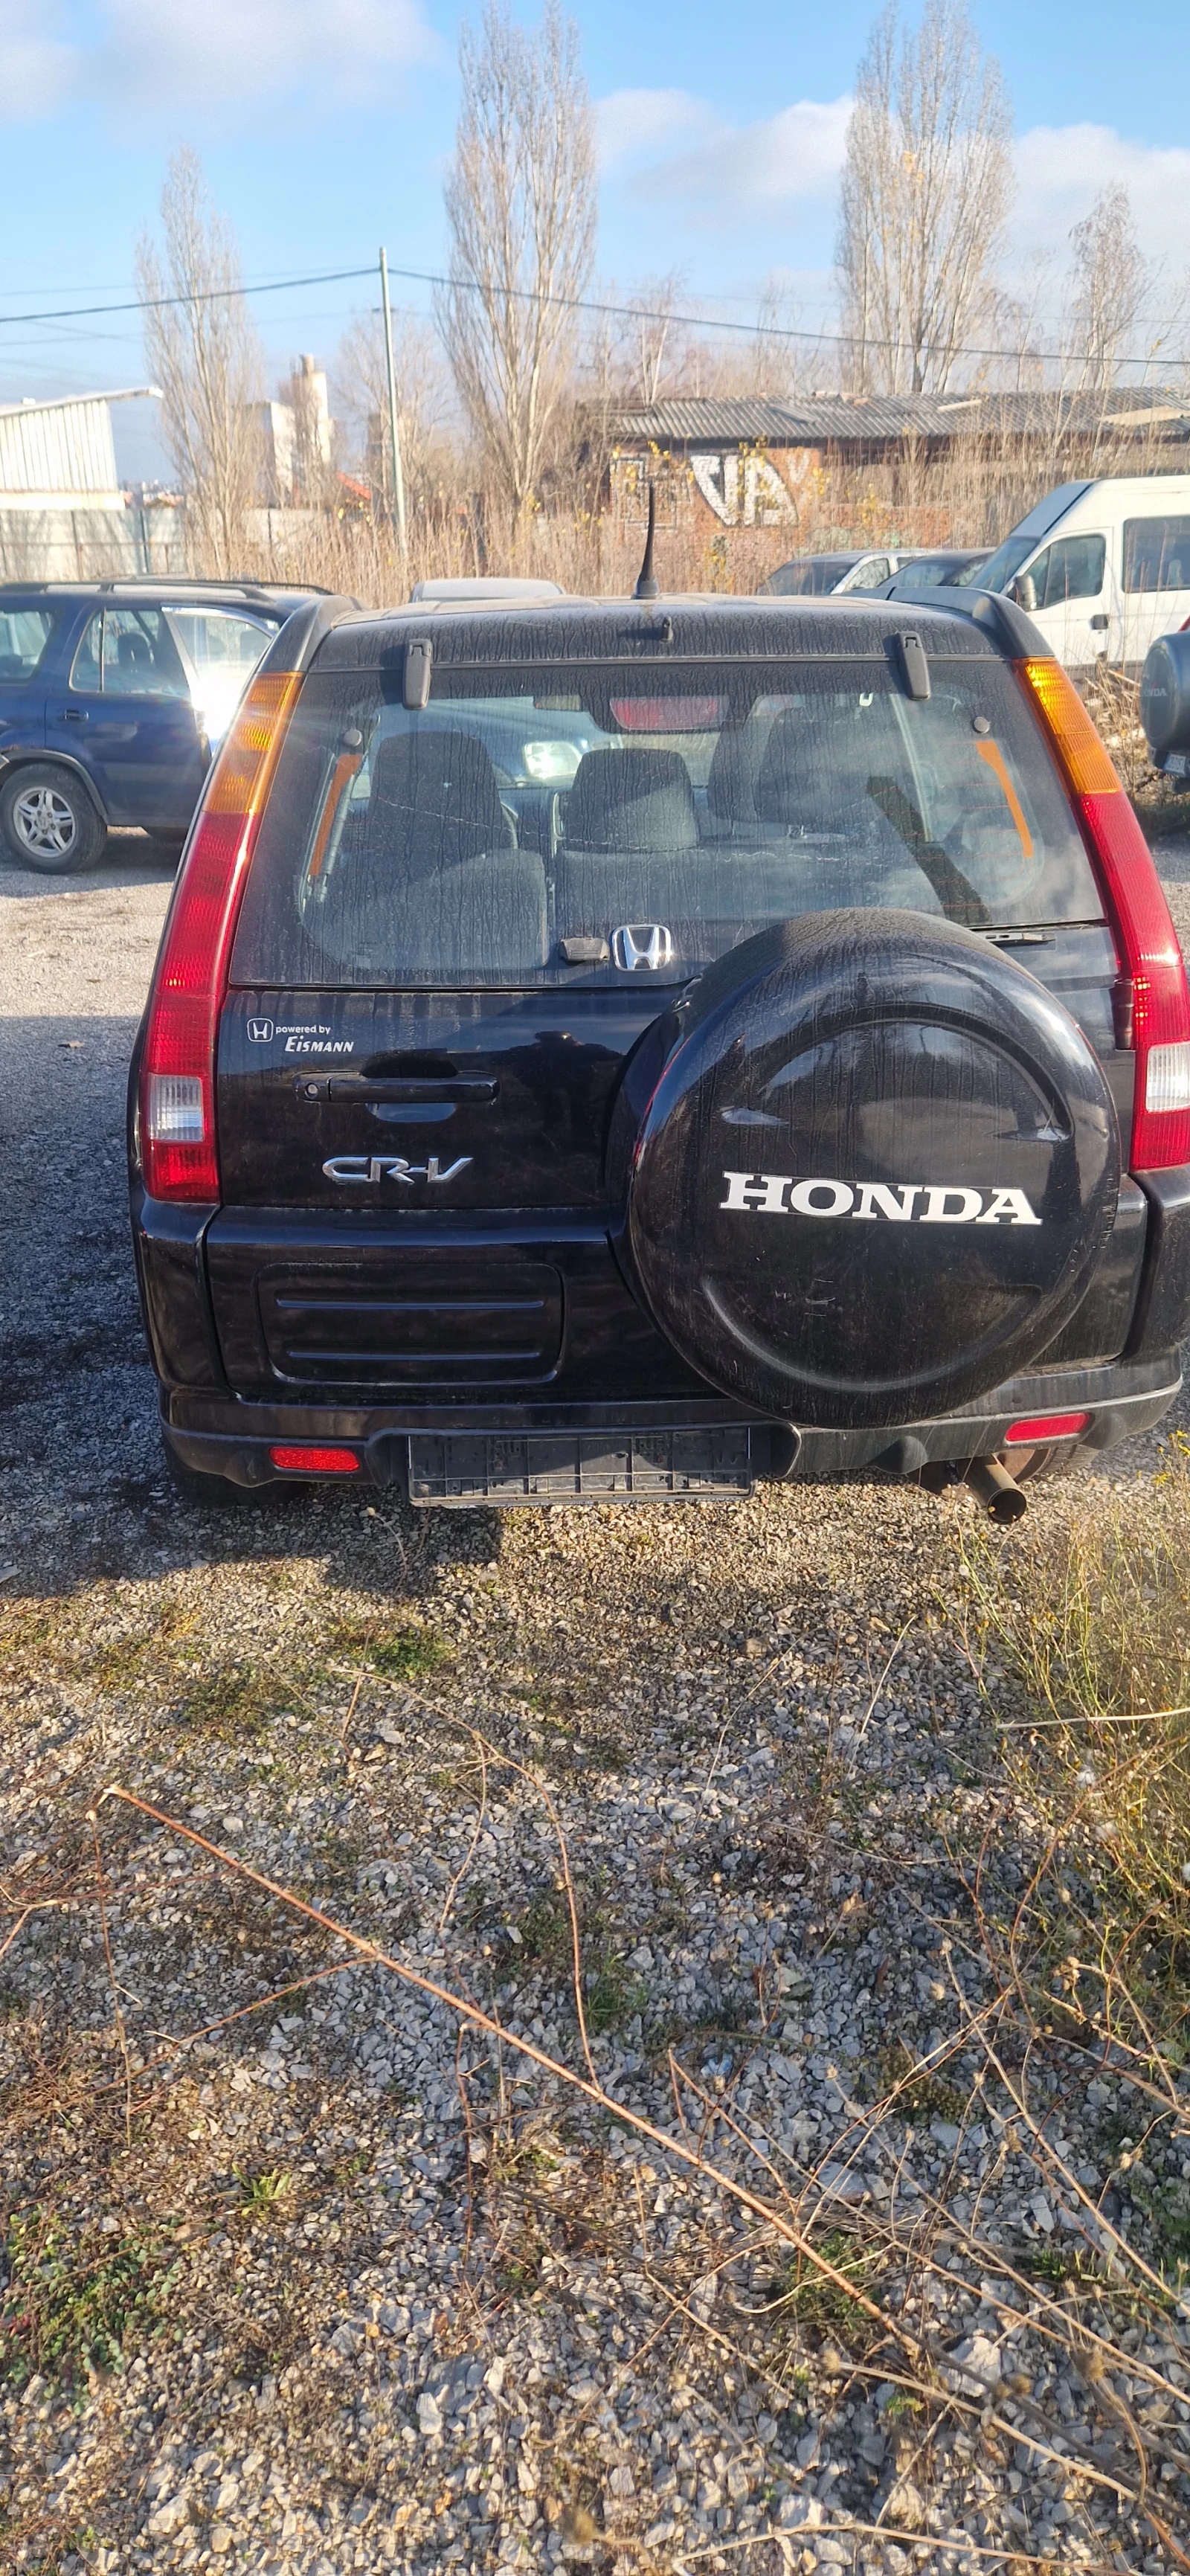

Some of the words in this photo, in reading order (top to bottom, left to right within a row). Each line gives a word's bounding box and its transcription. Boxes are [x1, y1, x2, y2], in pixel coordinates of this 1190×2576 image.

[275, 1025, 317, 1034] powered
[318, 1025, 331, 1034] by
[322, 1156, 474, 1184] CR-V
[719, 1171, 1042, 1225] HONDA
